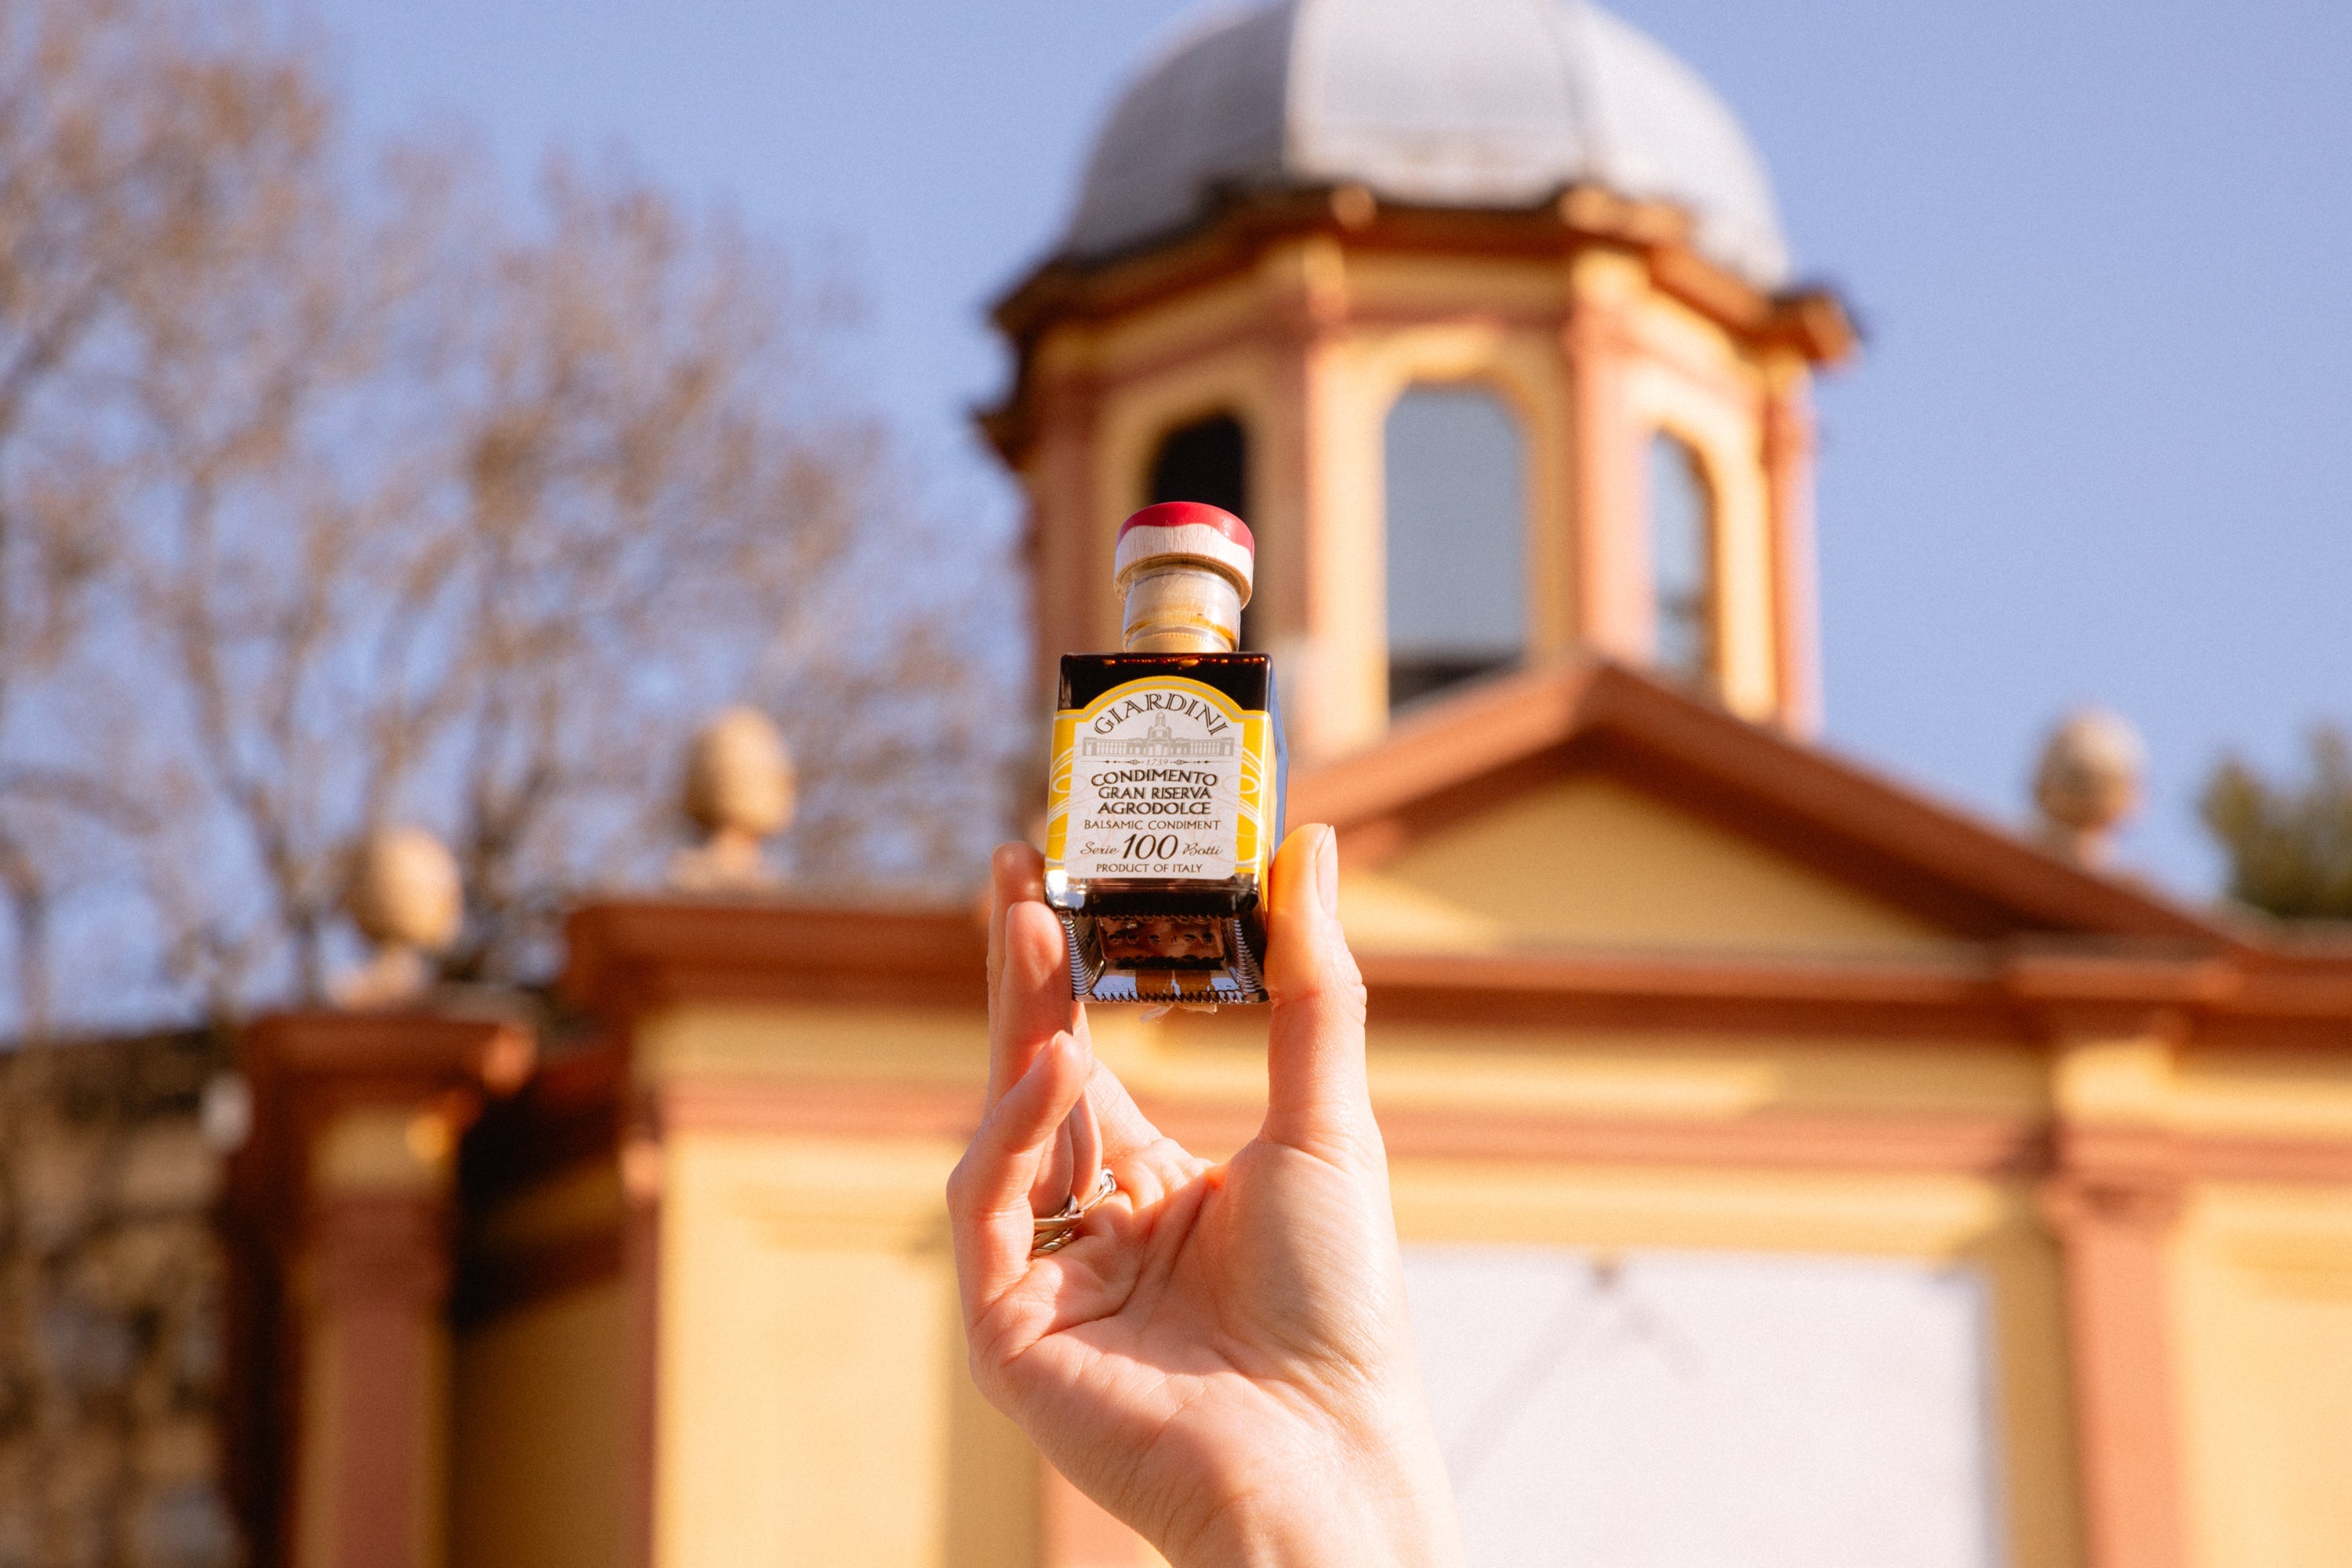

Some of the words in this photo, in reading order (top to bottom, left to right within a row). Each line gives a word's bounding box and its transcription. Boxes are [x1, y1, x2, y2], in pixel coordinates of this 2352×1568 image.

[1094, 692, 1228, 735] GIARDINI
[1146, 758, 1169, 767] 1739
[1091, 769, 1218, 786] CONDIMENTO
[1098, 787, 1146, 799] GRAN
[1151, 787, 1212, 799] RISERVA
[1098, 802, 1212, 815] AGRODOLCE
[1084, 820, 1143, 830] BALSAMIC
[1148, 820, 1221, 830] CONDIMENT
[1080, 841, 1120, 855] Serie
[1122, 833, 1179, 860] 100
[1184, 842, 1221, 855] Botti
[1096, 863, 1149, 873] PRODUCT
[1153, 863, 1170, 873] OF
[1173, 863, 1203, 873] ITALY
